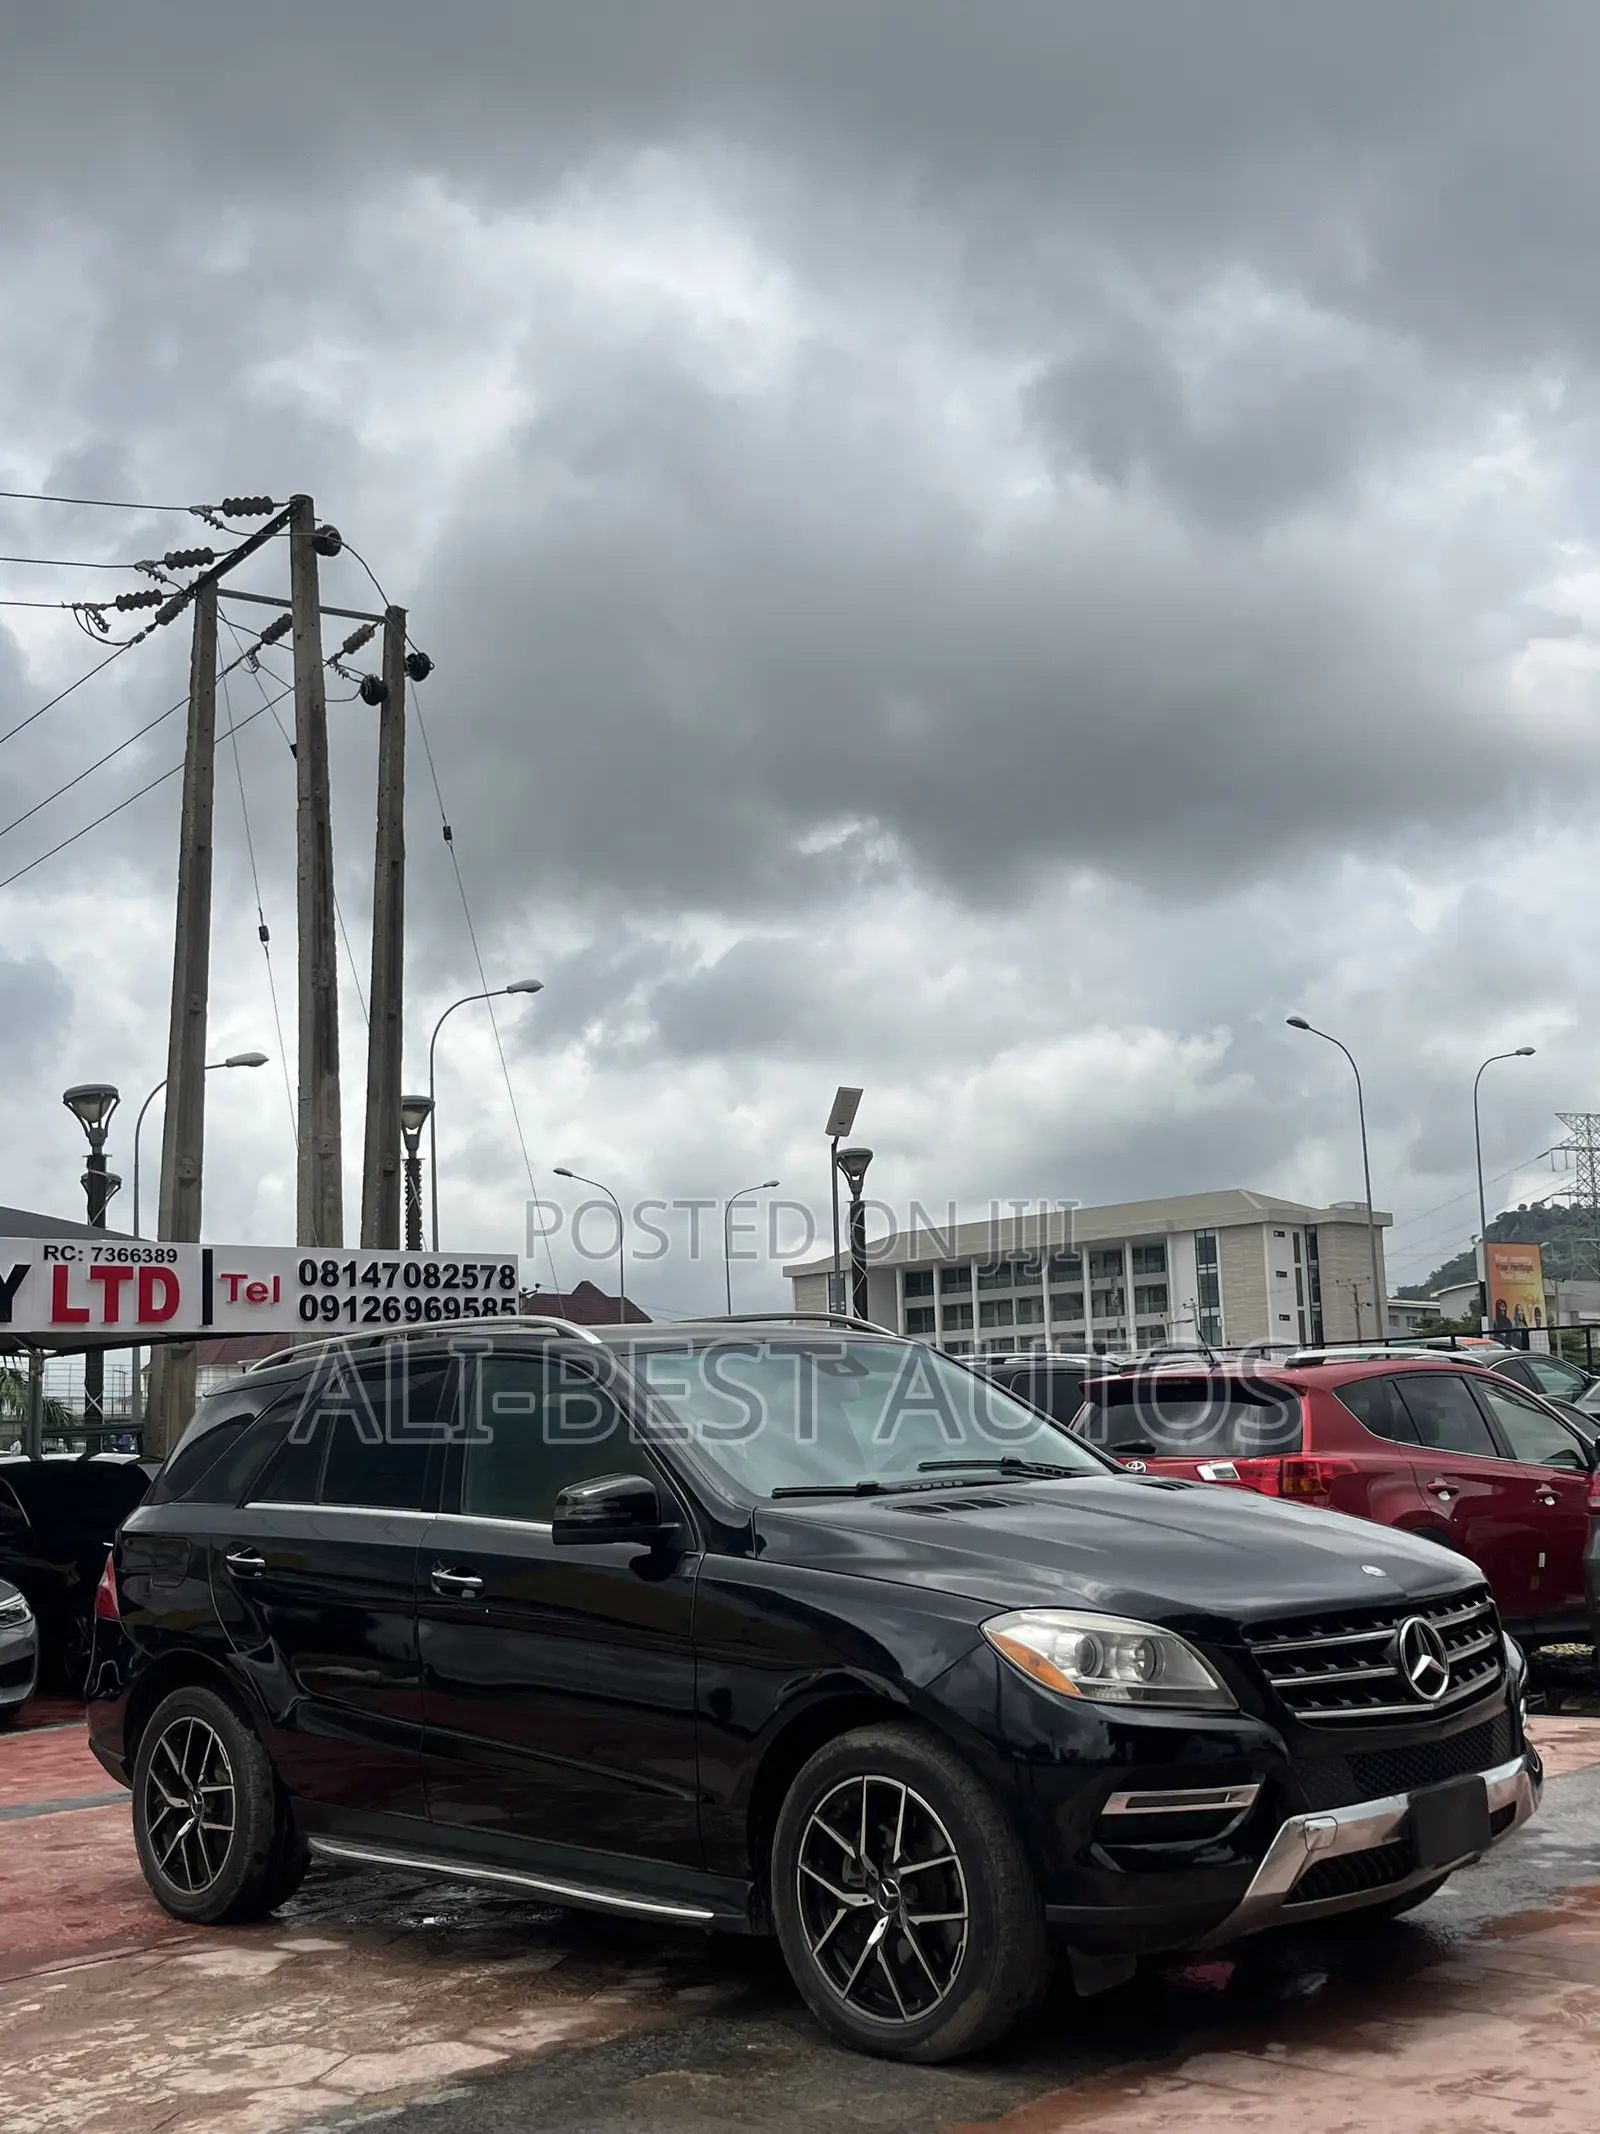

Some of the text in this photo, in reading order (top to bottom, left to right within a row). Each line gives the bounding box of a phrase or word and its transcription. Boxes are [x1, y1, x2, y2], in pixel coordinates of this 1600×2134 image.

[43, 1245, 178, 1263] RC: 7366389
[221, 1273, 281, 1304] Tel
[298, 1259, 516, 1290] 08147082578
[52, 1264, 181, 1323] LTD
[299, 1294, 517, 1323] 09126969585
